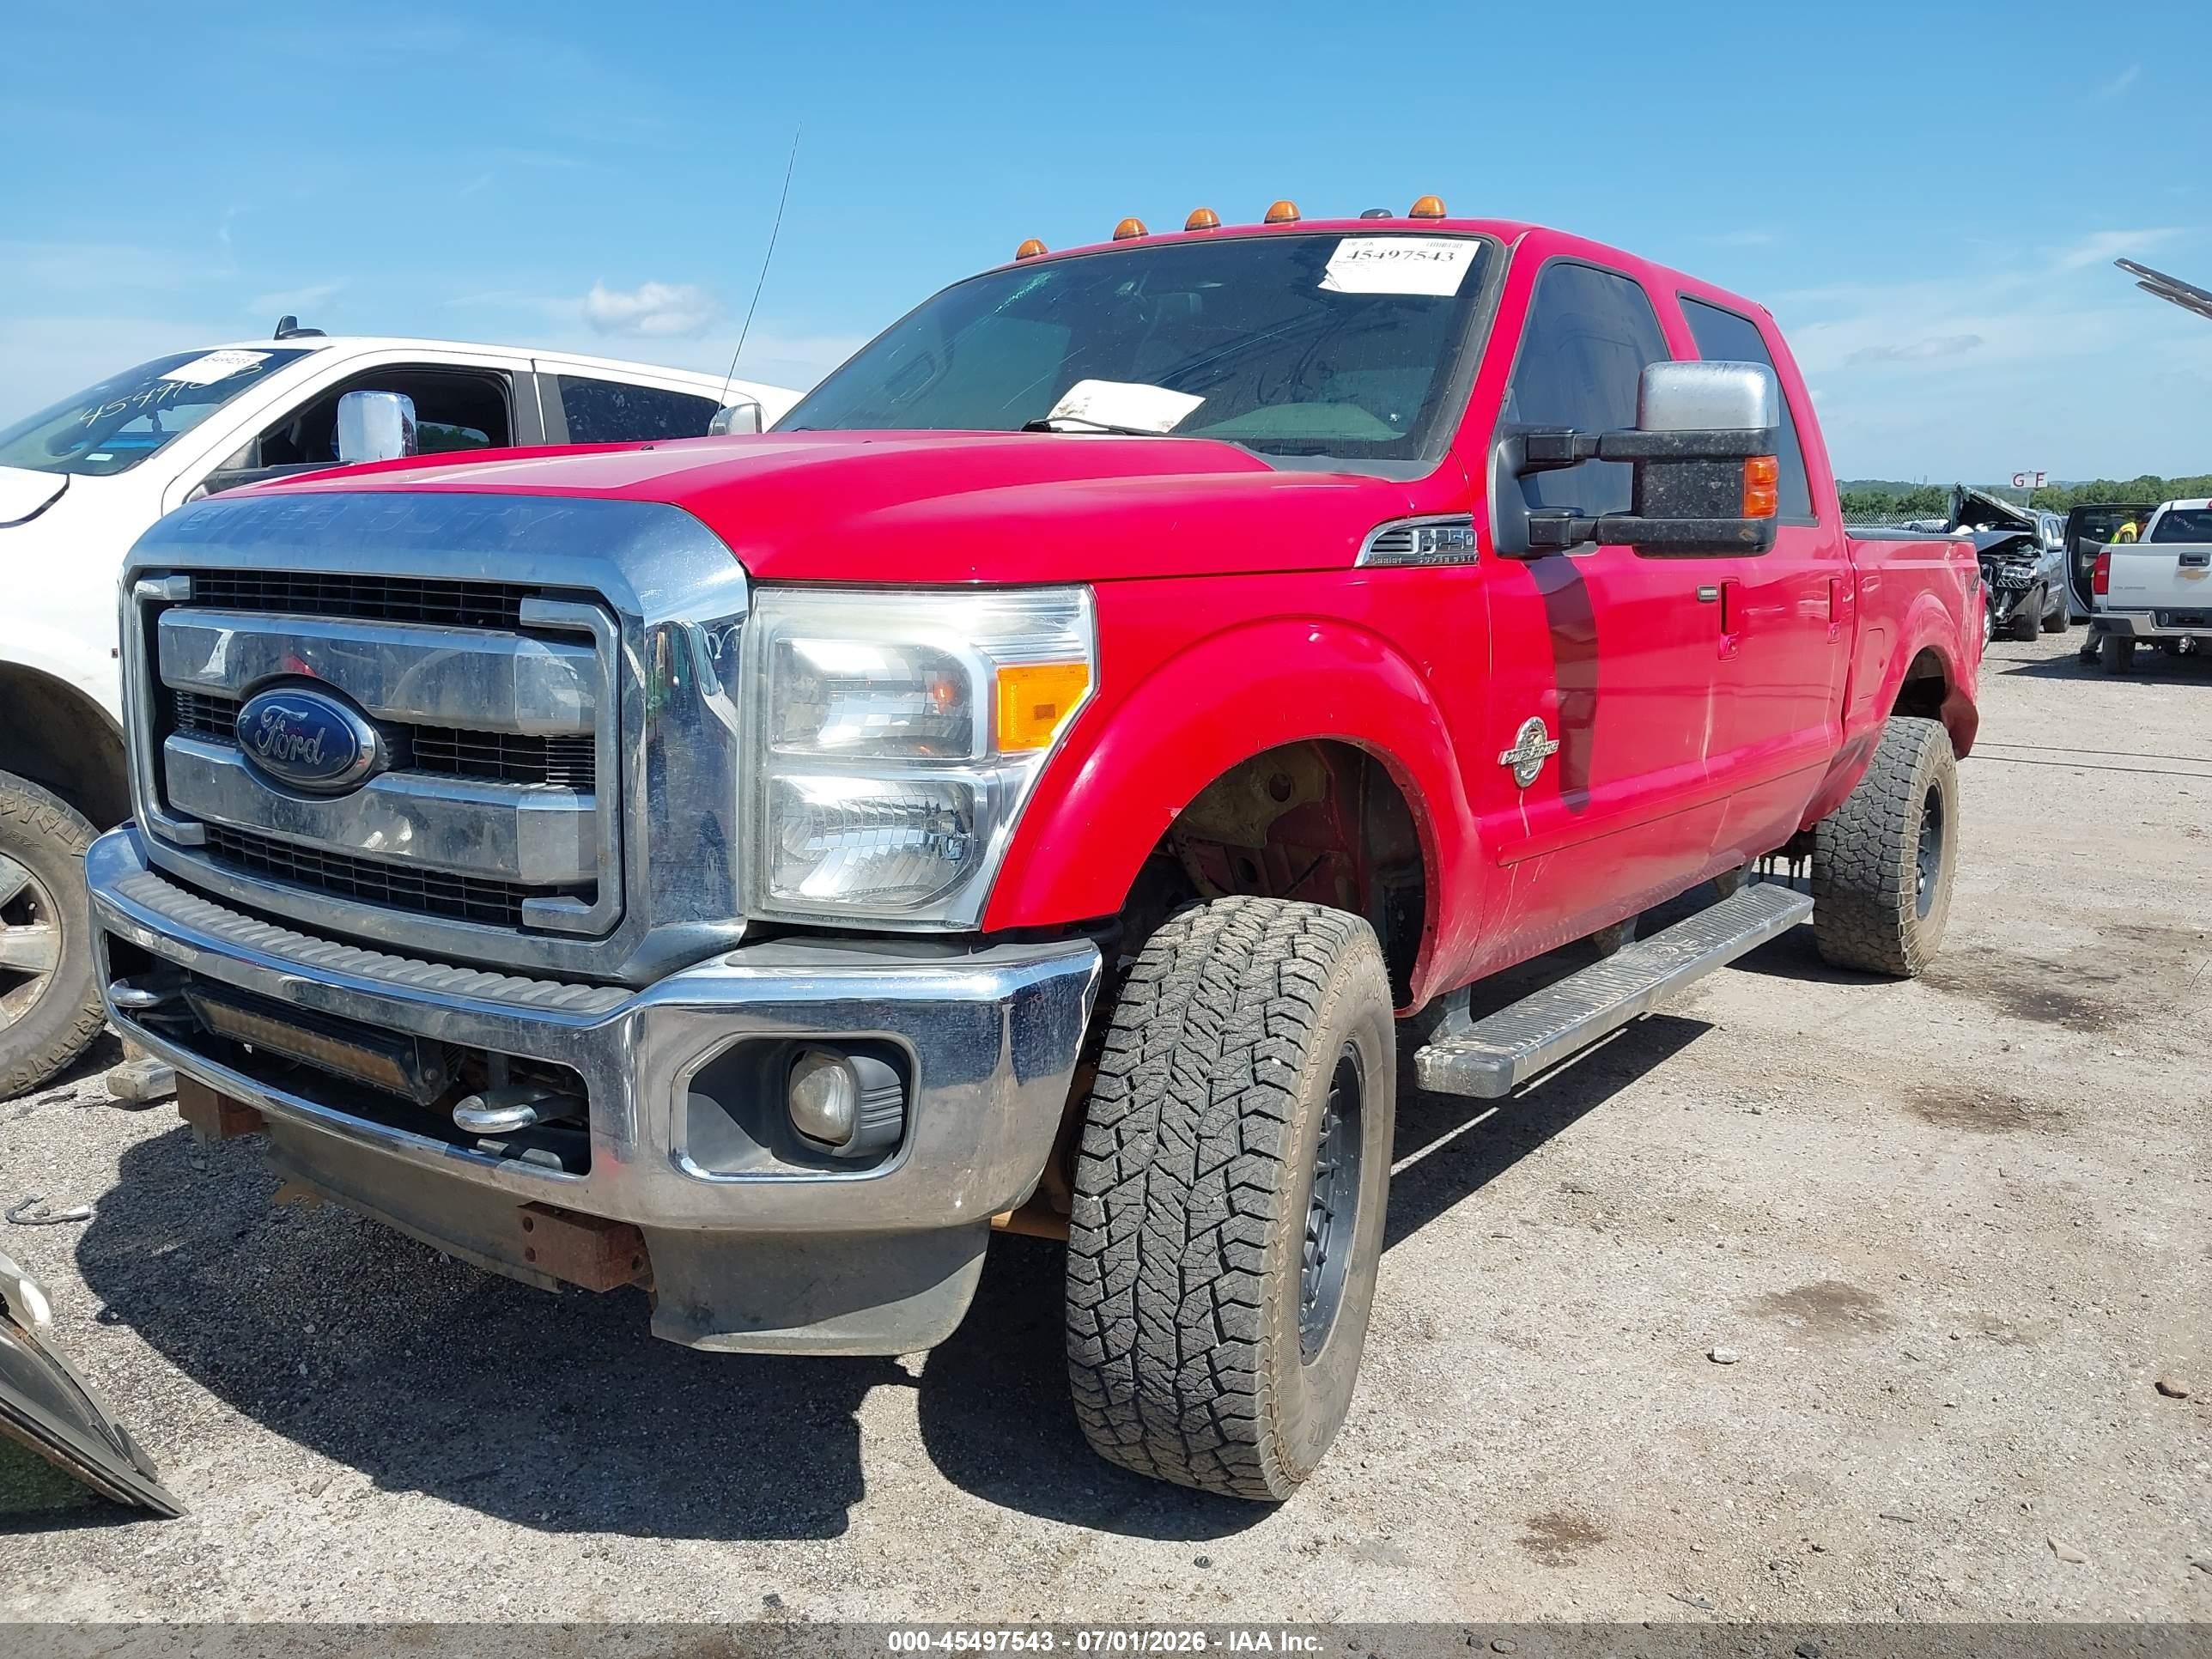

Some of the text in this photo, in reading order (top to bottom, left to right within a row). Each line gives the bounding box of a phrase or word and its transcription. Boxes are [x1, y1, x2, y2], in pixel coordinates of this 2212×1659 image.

[1346, 249, 1455, 262] 45497543
[2013, 472, 2045, 488] G F
[254, 705, 325, 766] Ford
